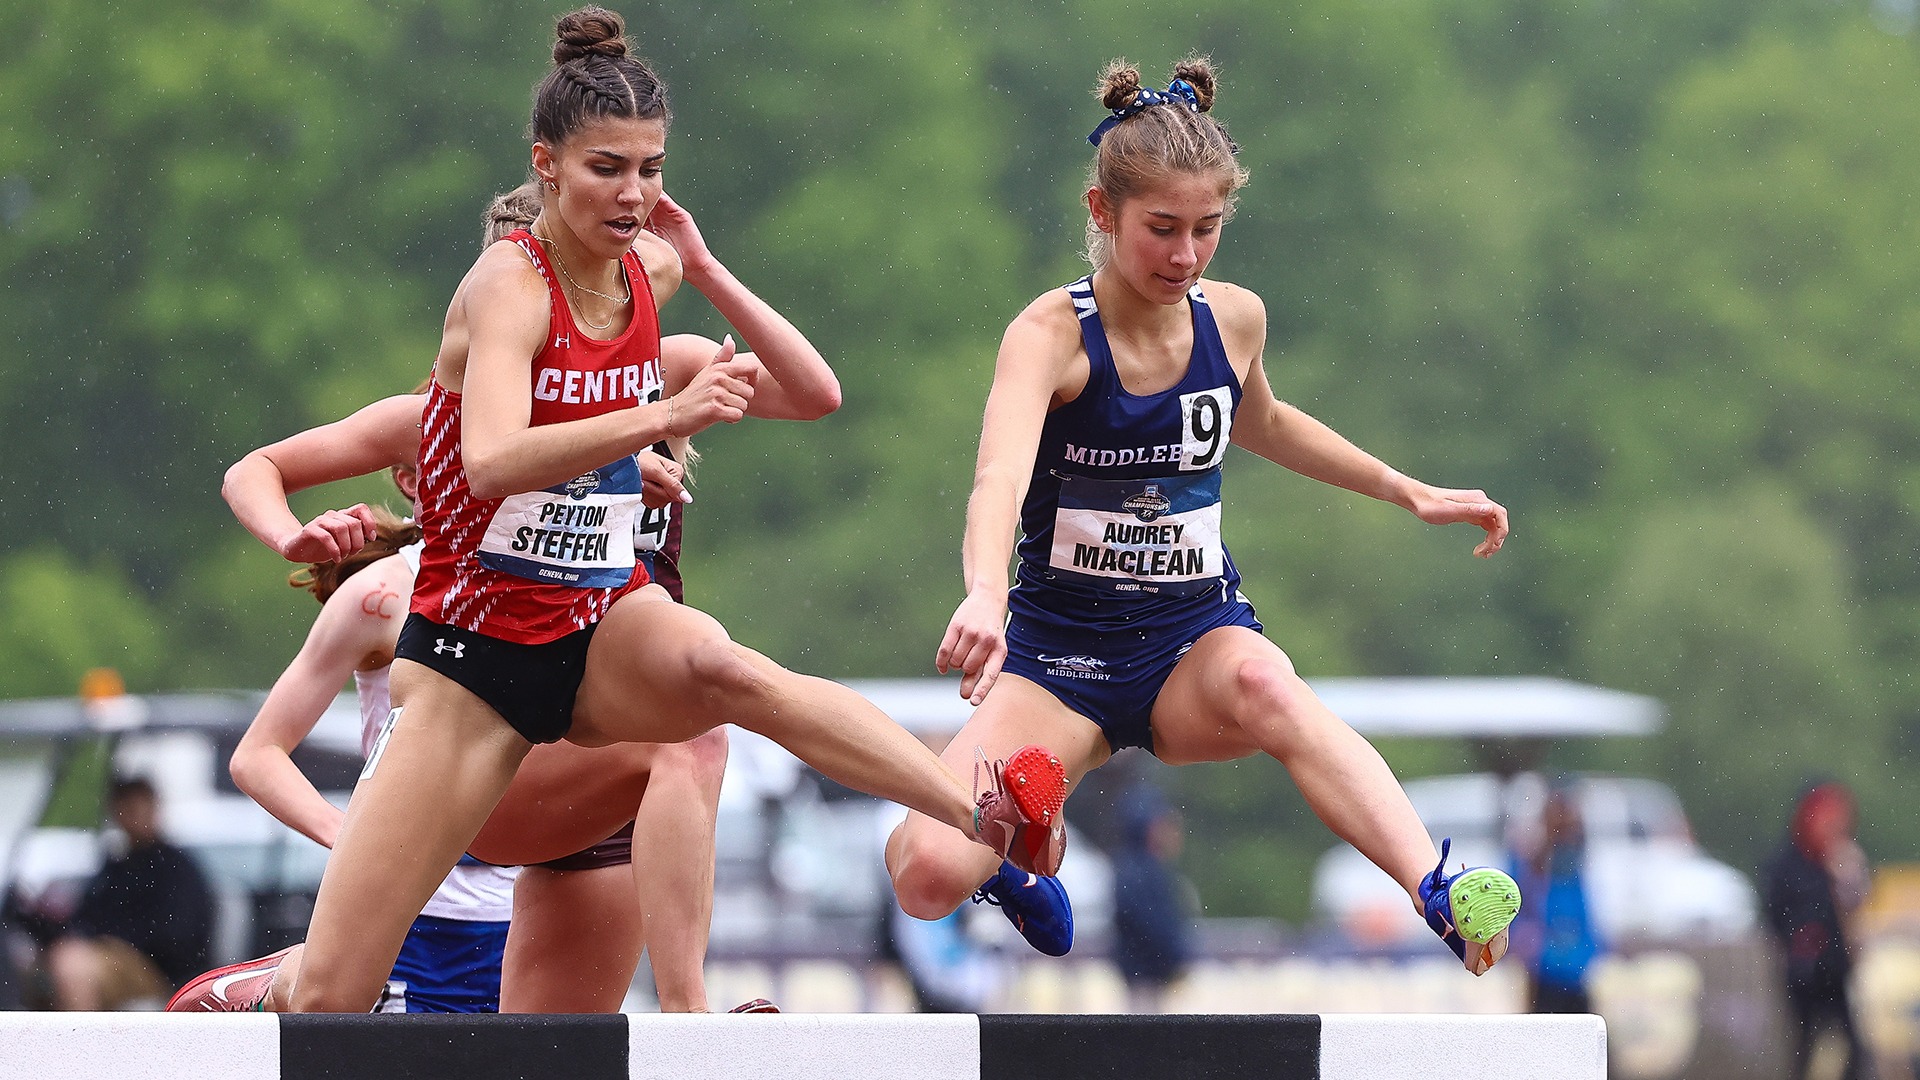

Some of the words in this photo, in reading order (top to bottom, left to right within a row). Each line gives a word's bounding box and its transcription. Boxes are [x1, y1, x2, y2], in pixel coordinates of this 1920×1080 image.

[1191, 394, 1221, 466] 9
[1064, 443, 1184, 467] MIDDLEB
[539, 502, 608, 527] PEYTON
[640, 508, 668, 545] 4
[511, 526, 610, 561] STEFFEN
[1102, 522, 1185, 545] AUDREY
[1072, 542, 1204, 576] MACLEAN
[564, 573, 580, 582] OHIO
[1142, 585, 1159, 594] OHIO
[1046, 668, 1111, 681] MIDDLEBURY
